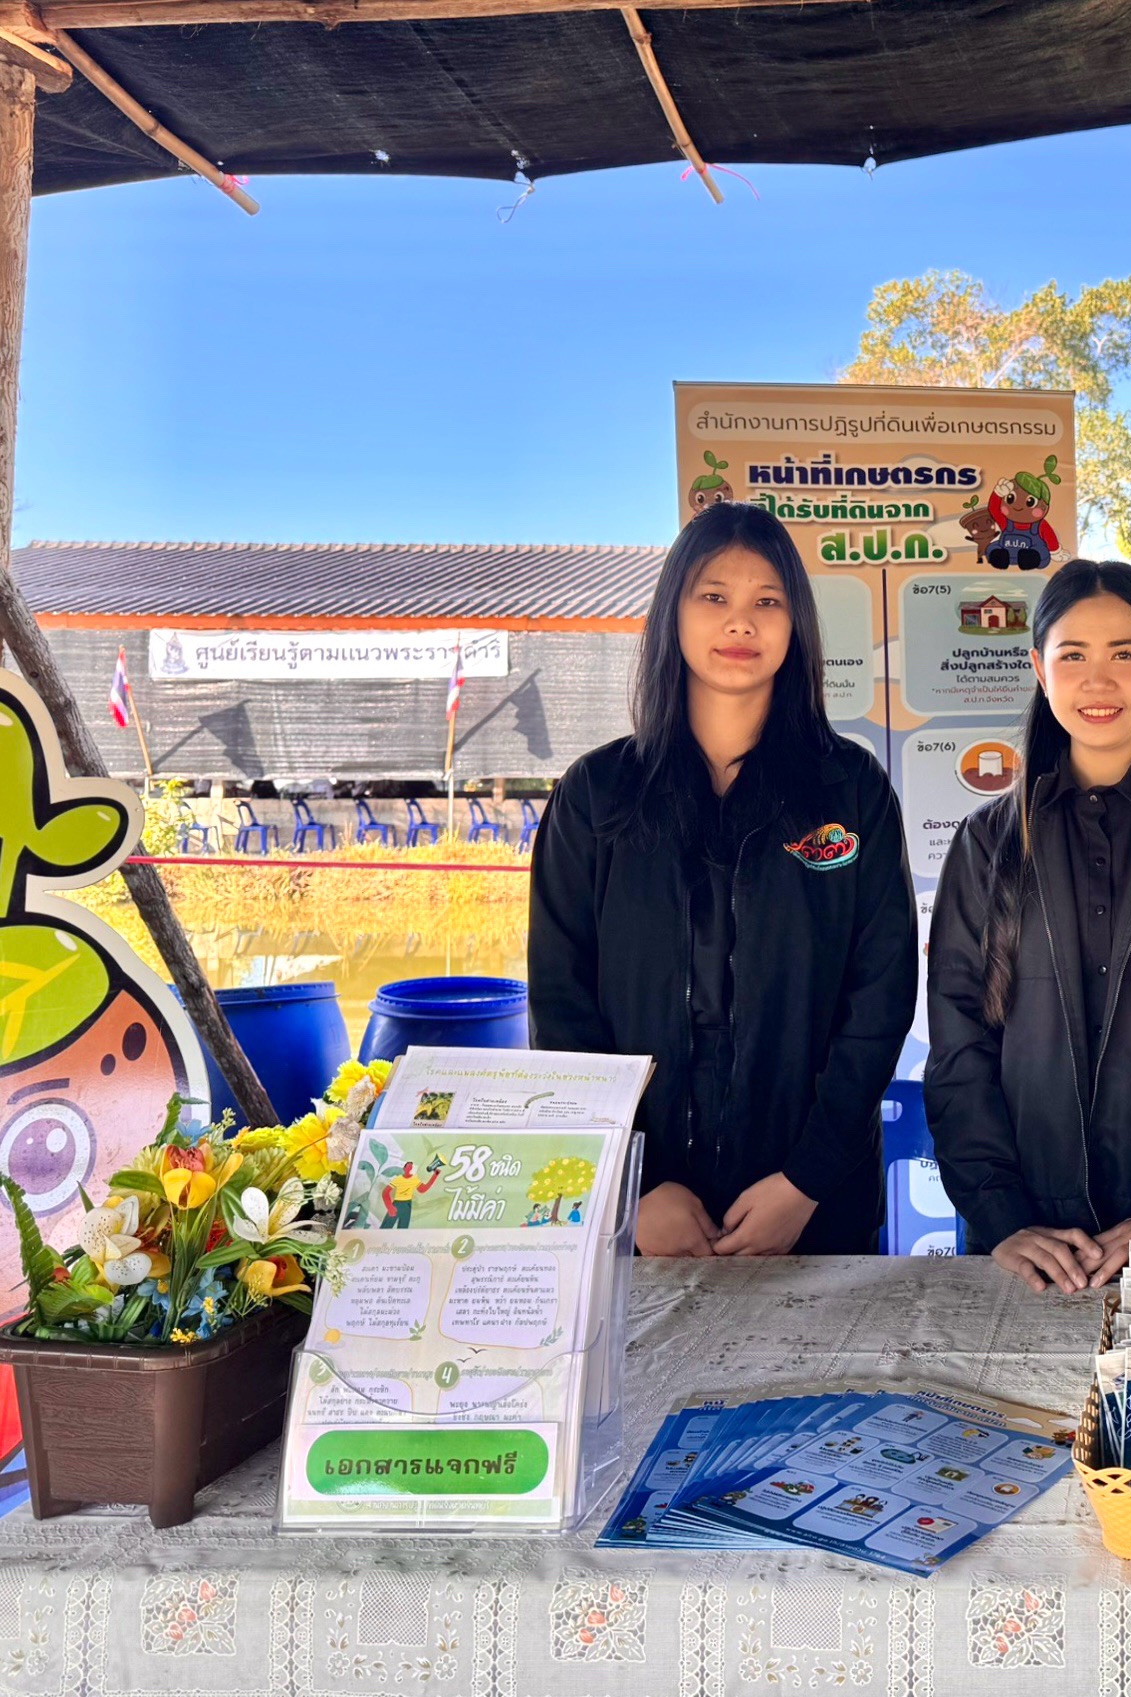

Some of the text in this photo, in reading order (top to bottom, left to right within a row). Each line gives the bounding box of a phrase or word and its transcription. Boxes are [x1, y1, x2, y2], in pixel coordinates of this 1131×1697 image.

[696, 410, 1056, 438] สำนักงานการปฏิรูปที่ดินเพื่อเกษตรกรรม
[748, 454, 977, 485] หน้าที่เกษตรกร
[820, 528, 944, 561] ส.ป.ก.
[912, 583, 952, 596] ข้อ7(5)
[952, 646, 1029, 660] ปลูกบ้านหรือ
[822, 658, 864, 667] ตนเอง
[916, 740, 957, 752] ข้อ7(6)
[444, 1144, 522, 1182] 58 ชนิด
[444, 1185, 507, 1221] ไม้มีค่า
[352, 1242, 360, 1259] 1
[457, 1238, 469, 1254] 2
[442, 1366, 453, 1384] 4
[324, 1450, 518, 1476] เอกสารแจกฟรี
